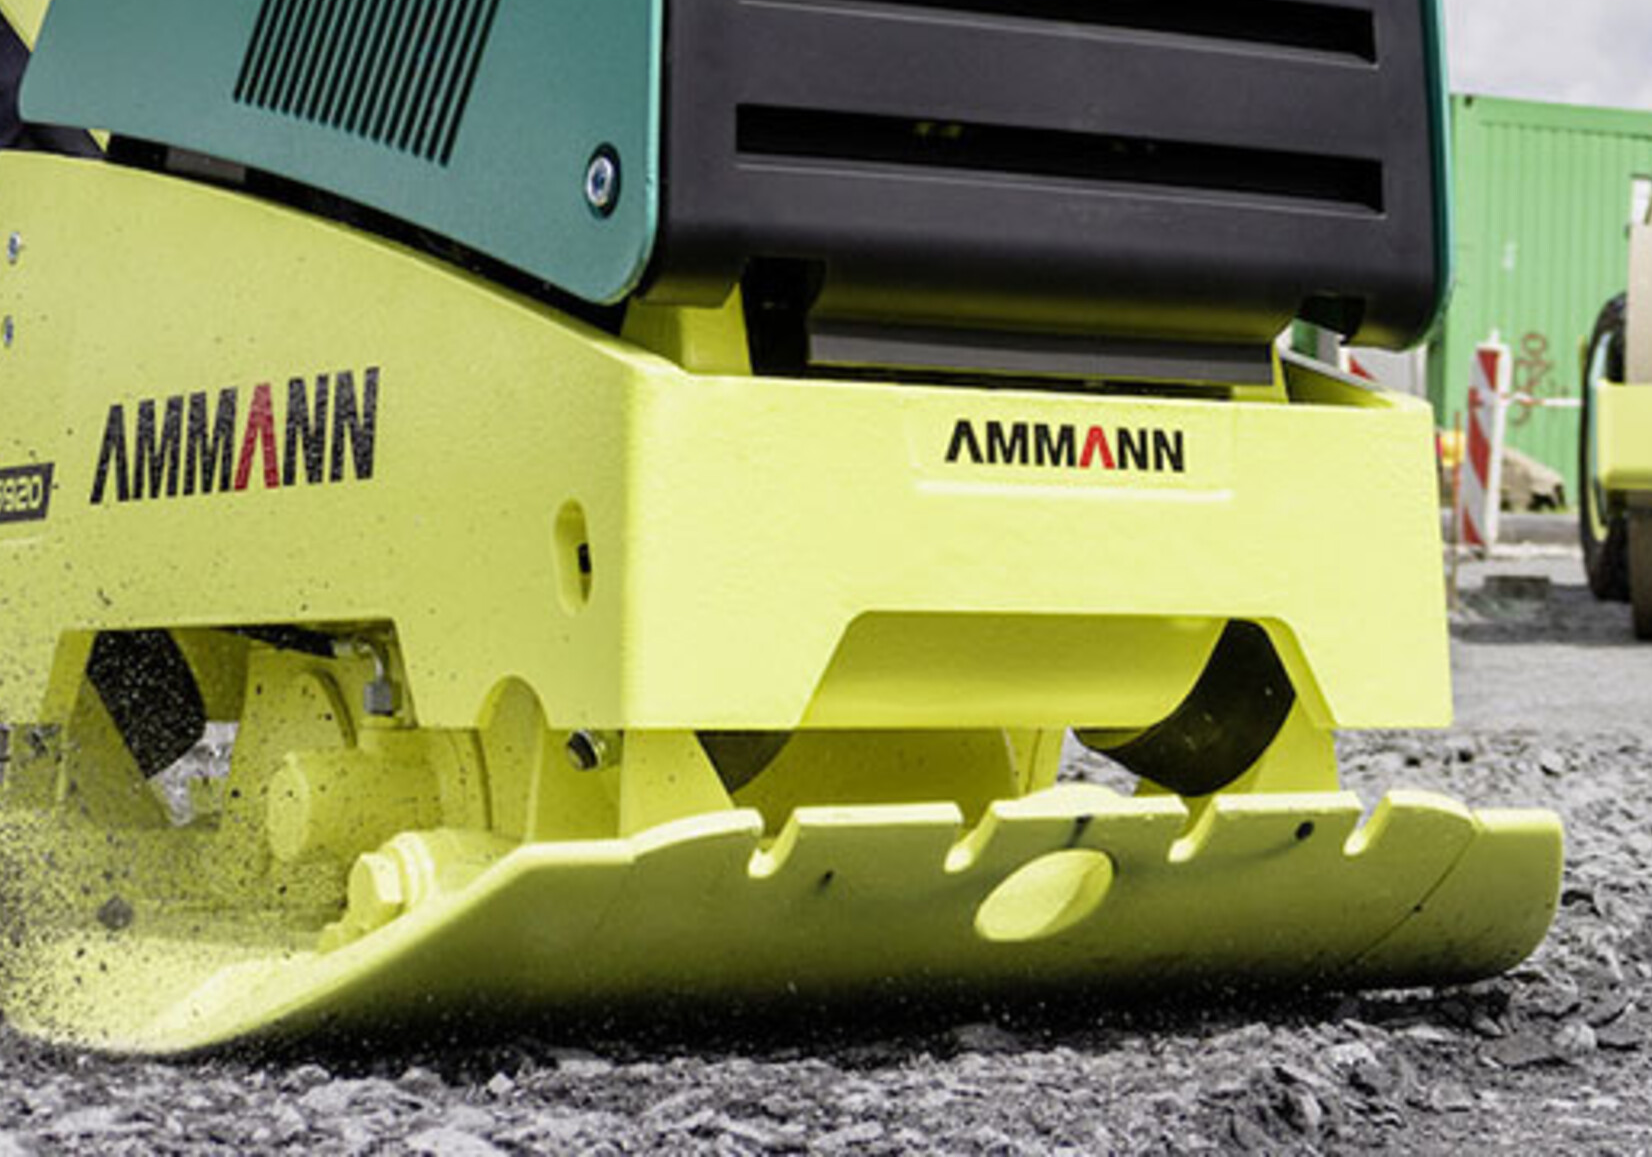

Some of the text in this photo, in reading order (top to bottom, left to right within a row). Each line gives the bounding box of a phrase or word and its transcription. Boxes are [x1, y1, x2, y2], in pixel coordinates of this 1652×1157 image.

[90, 366, 380, 504] AMMANN
[945, 419, 1185, 472] AMMANN
[0, 474, 43, 512] 920
